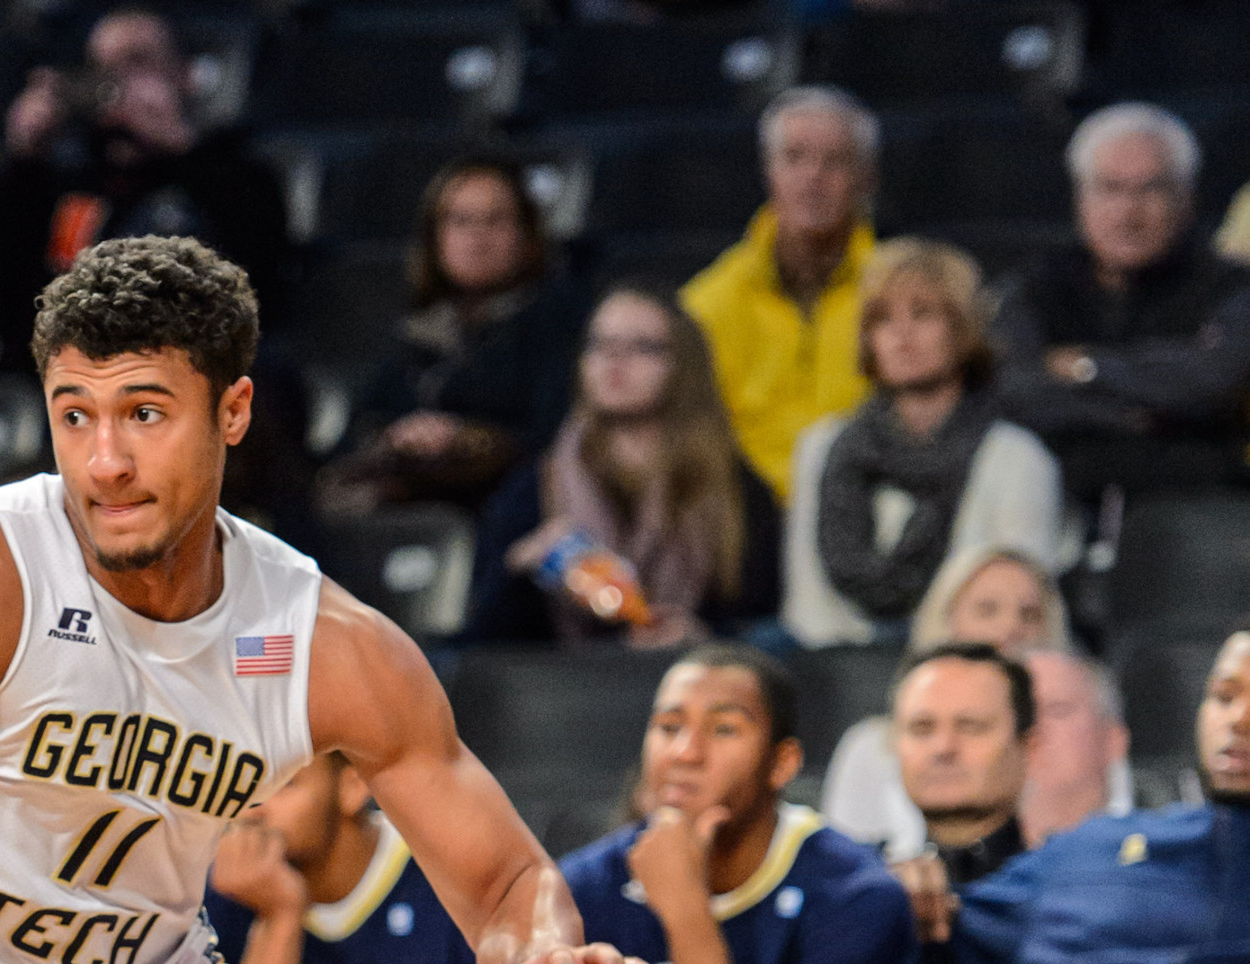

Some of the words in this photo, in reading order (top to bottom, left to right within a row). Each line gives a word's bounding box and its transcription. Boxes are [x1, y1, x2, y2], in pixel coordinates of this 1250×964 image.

[47, 628, 97, 645] RUSSELL
[21, 710, 266, 820] GEORGIA
[53, 808, 162, 892] 11
